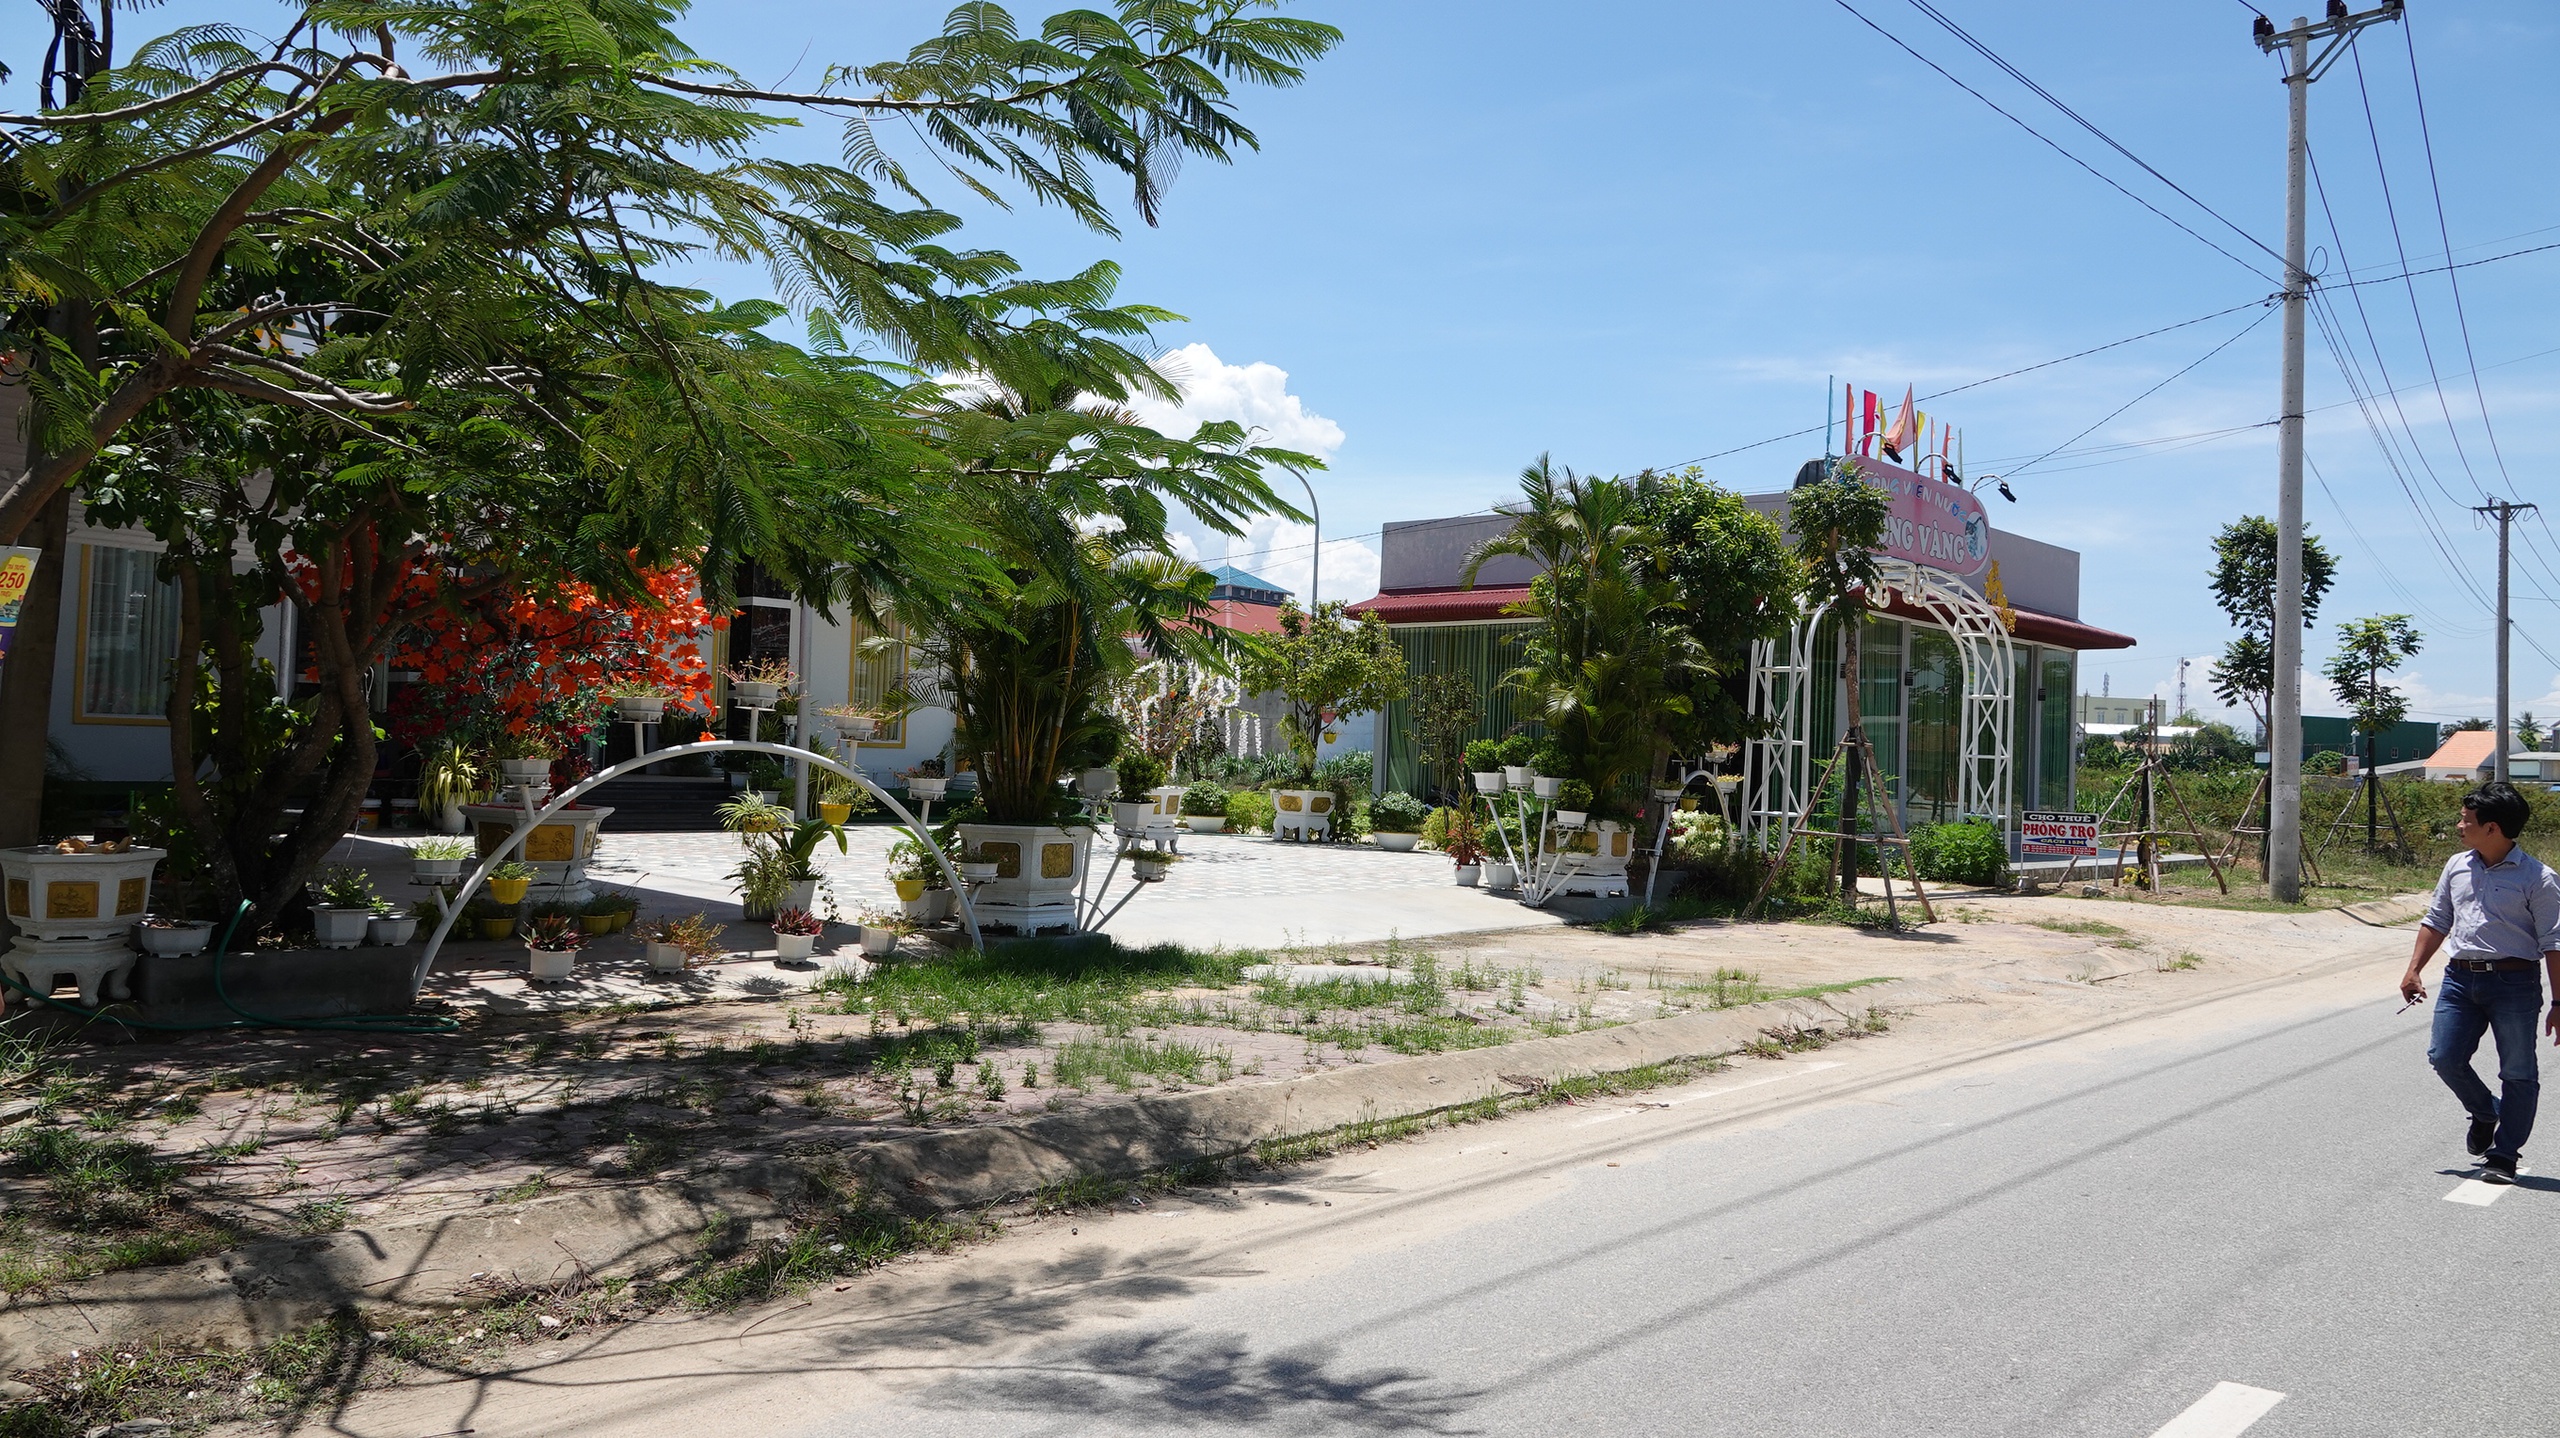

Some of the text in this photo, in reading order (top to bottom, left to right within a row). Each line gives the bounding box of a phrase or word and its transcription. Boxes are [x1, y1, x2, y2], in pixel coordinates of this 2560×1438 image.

[1917, 520, 1965, 564] VÀNG
[0, 571, 25, 588] 250
[2058, 814, 2091, 822] THUÊ
[2023, 820, 2096, 841] PHÒNG TRỌ
